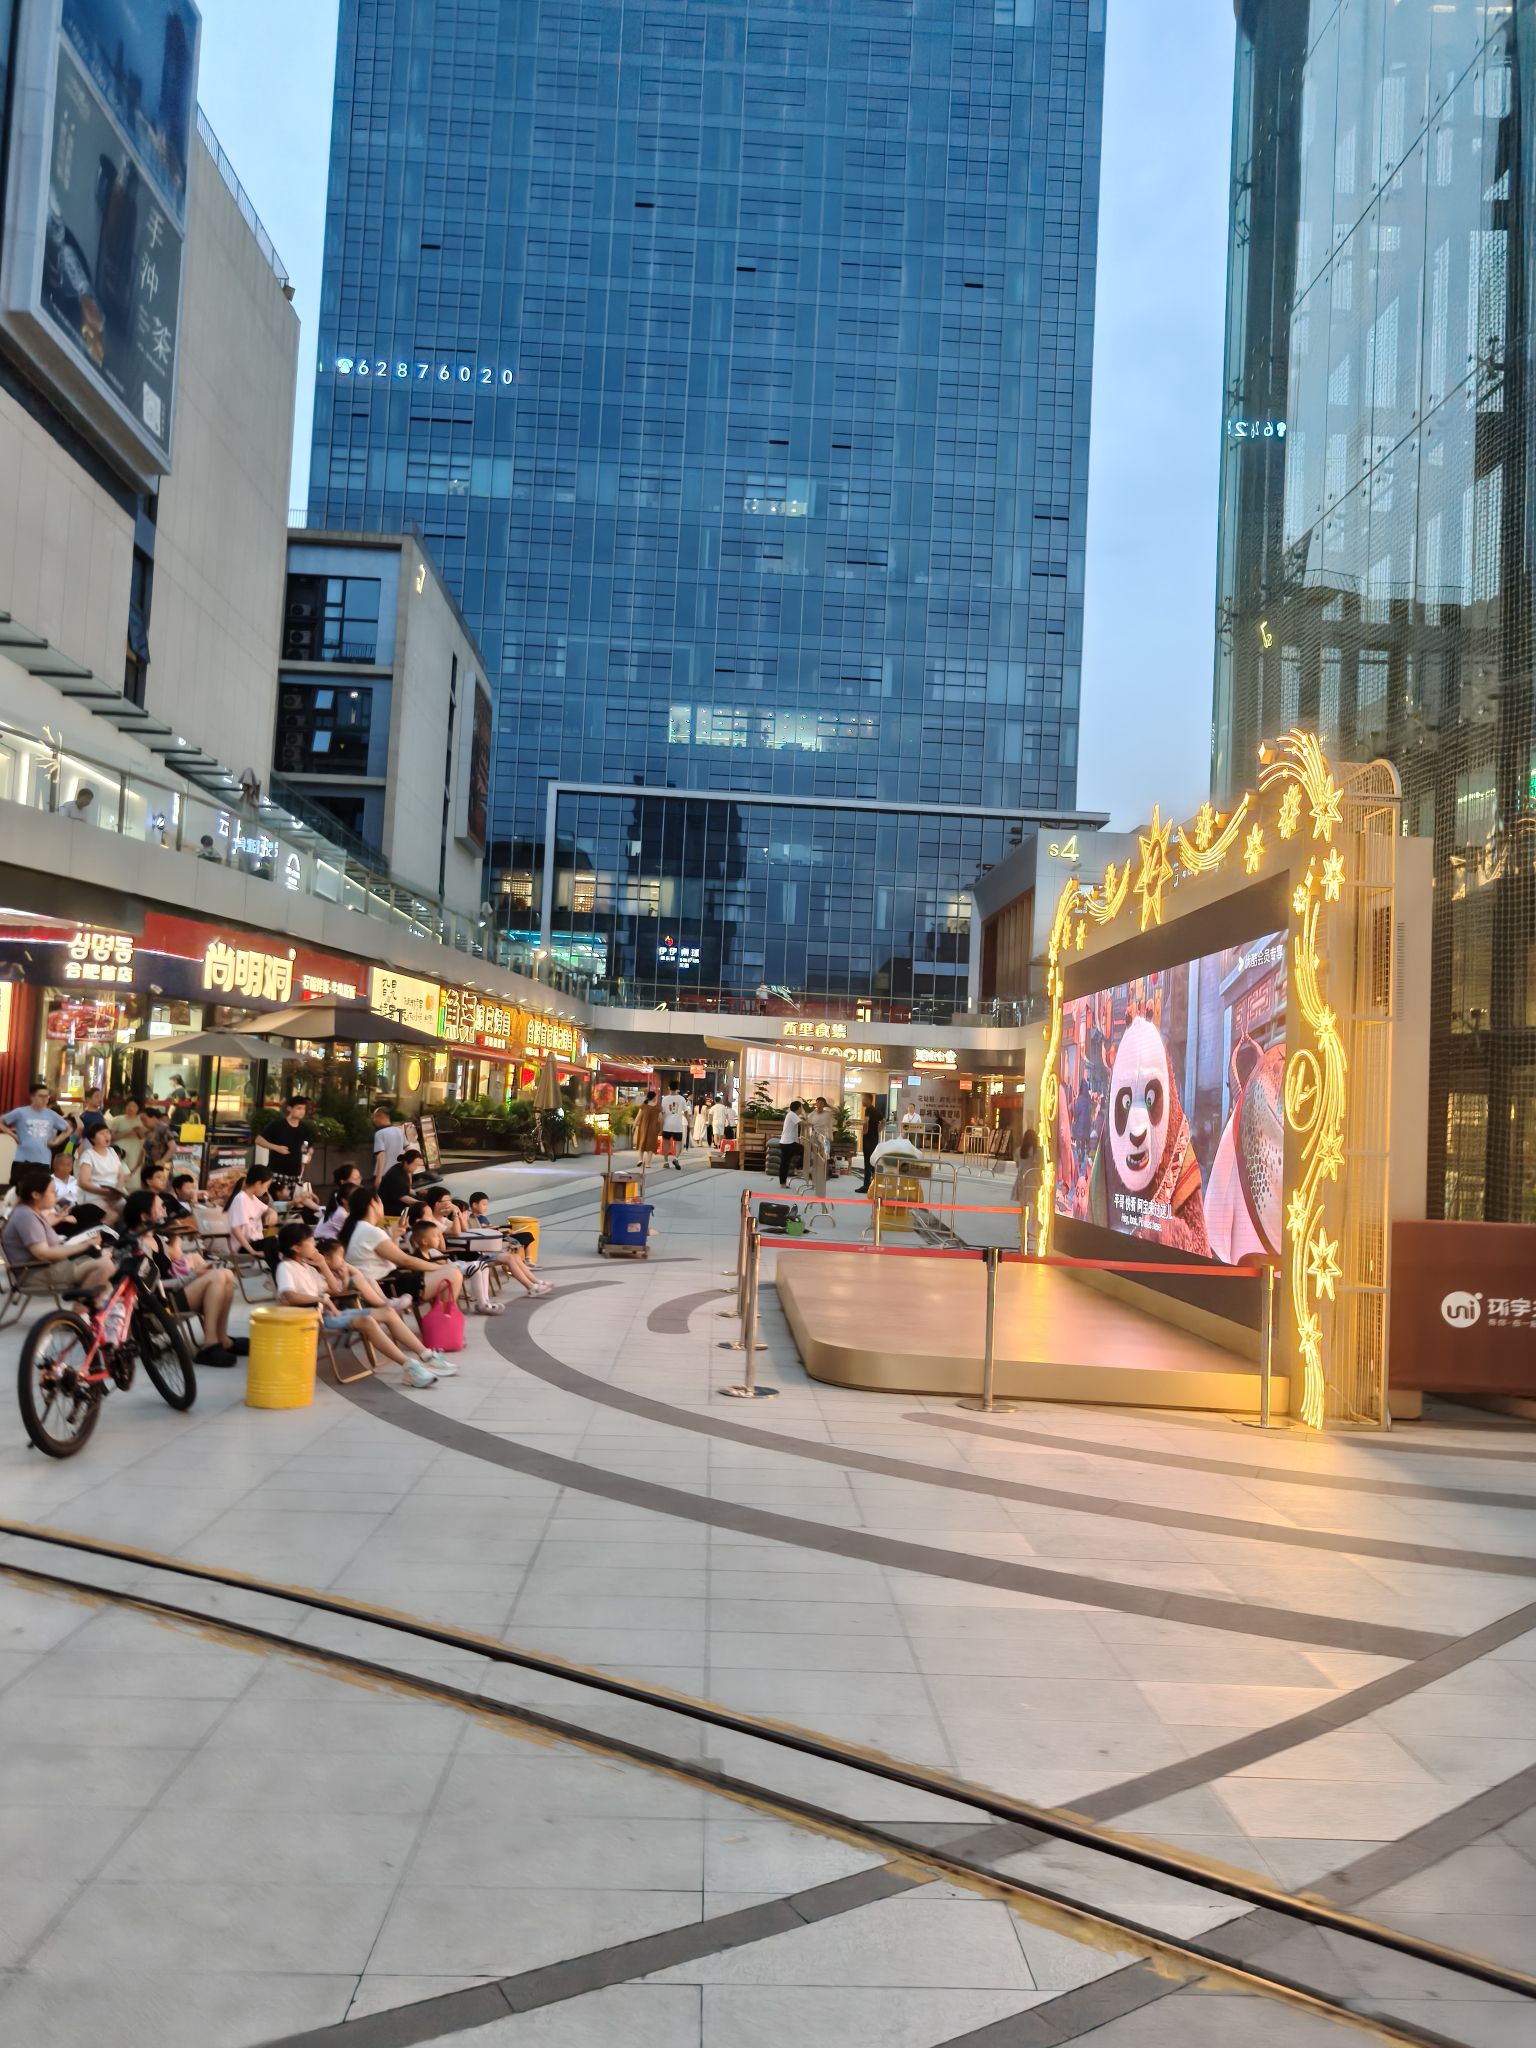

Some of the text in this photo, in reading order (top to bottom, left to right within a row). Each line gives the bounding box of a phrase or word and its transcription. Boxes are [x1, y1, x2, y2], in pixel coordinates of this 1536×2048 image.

[359, 360, 513, 385] 62876020
[203, 941, 293, 1003] 尚明洞
[1487, 1297, 1536, 1318] 环宇
